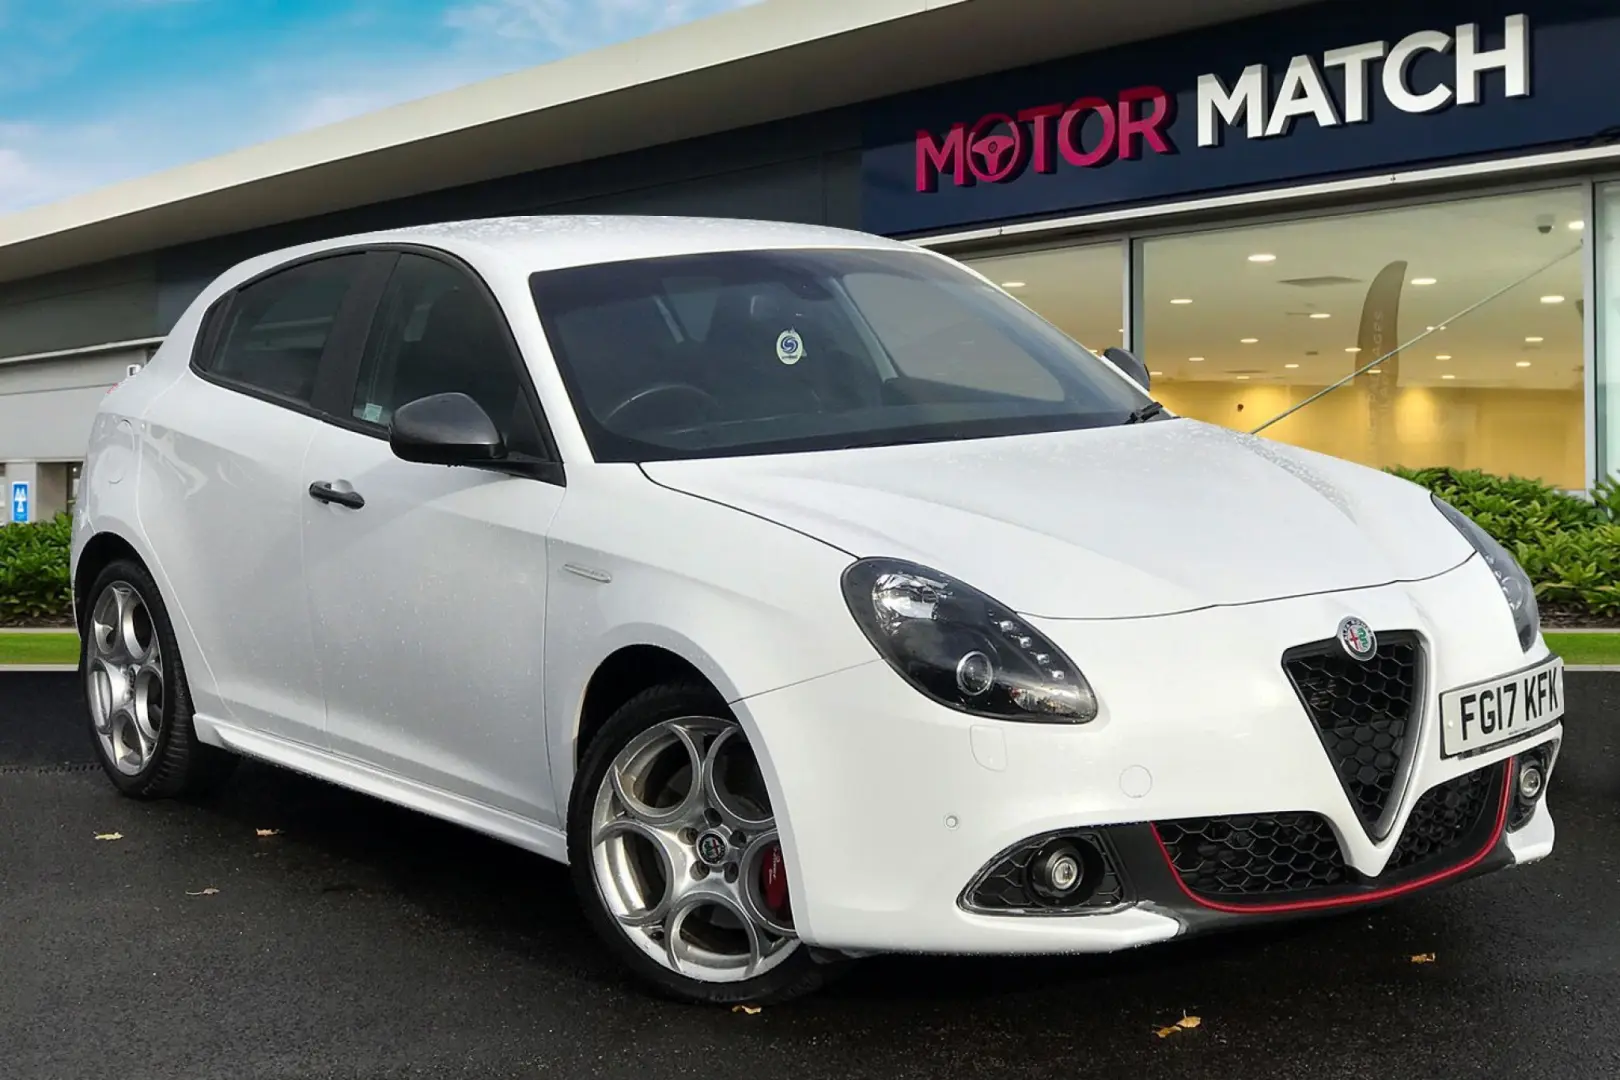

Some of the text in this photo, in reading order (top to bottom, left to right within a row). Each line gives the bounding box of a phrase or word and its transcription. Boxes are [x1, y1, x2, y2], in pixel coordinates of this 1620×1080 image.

[915, 13, 1530, 191] MOTOR MATCH
[1459, 666, 1559, 741] FG17 KFK
